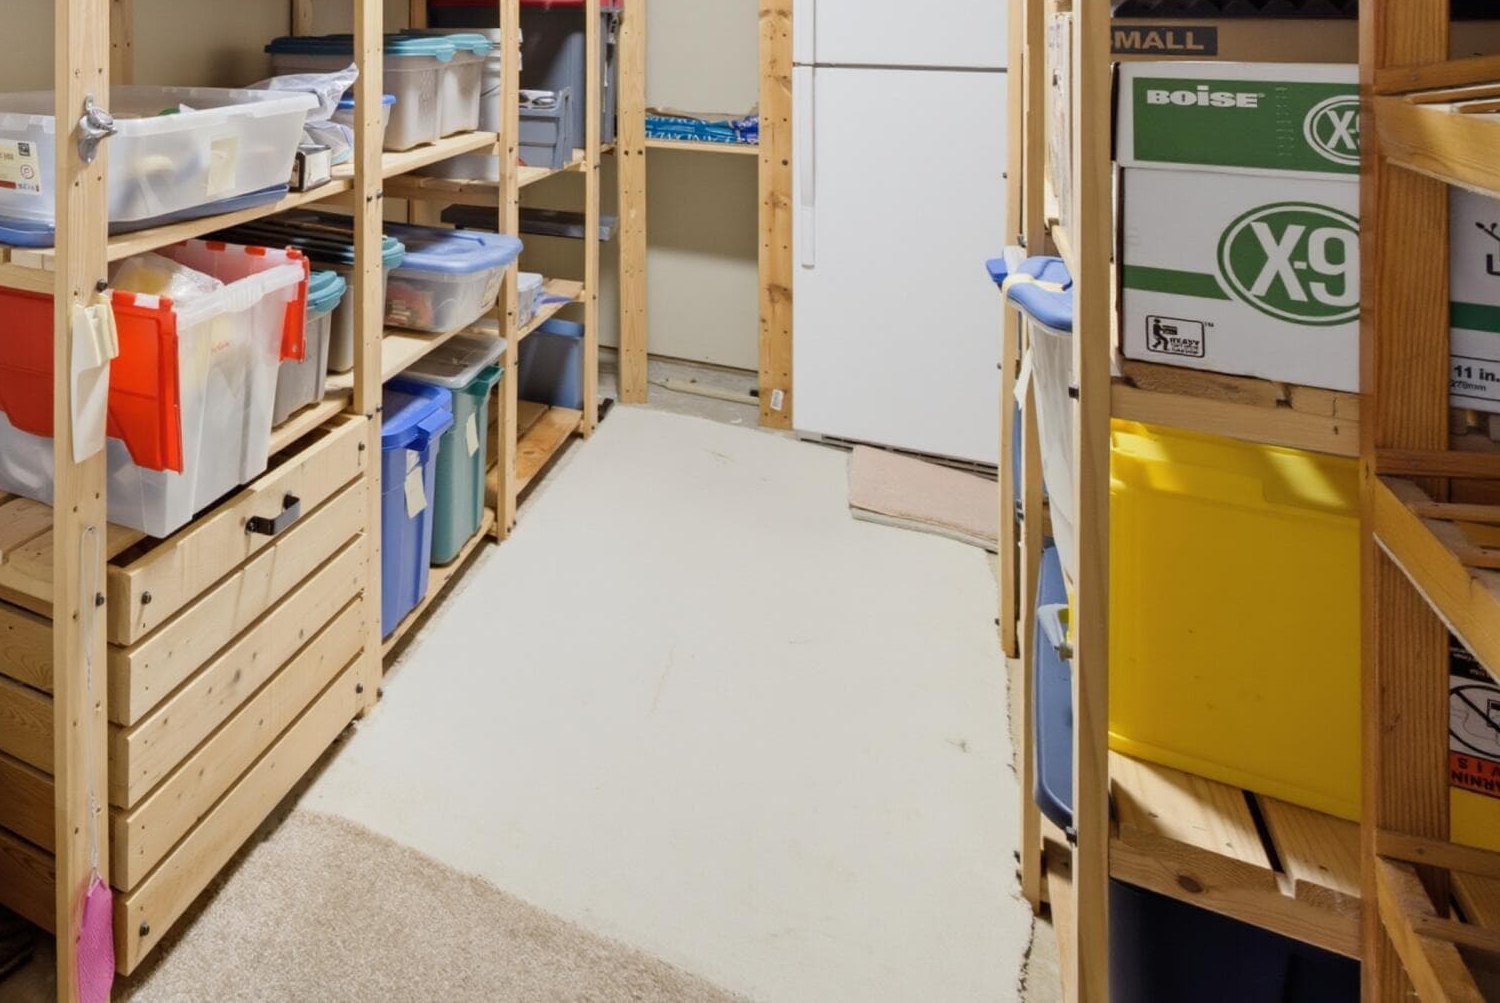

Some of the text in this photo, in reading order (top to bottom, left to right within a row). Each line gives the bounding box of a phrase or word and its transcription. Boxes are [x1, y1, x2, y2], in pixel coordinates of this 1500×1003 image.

[1111, 30, 1205, 51] MALL
[1325, 109, 1360, 151] X-
[1248, 220, 1360, 308] X-9
[1453, 365, 1473, 379] 11
